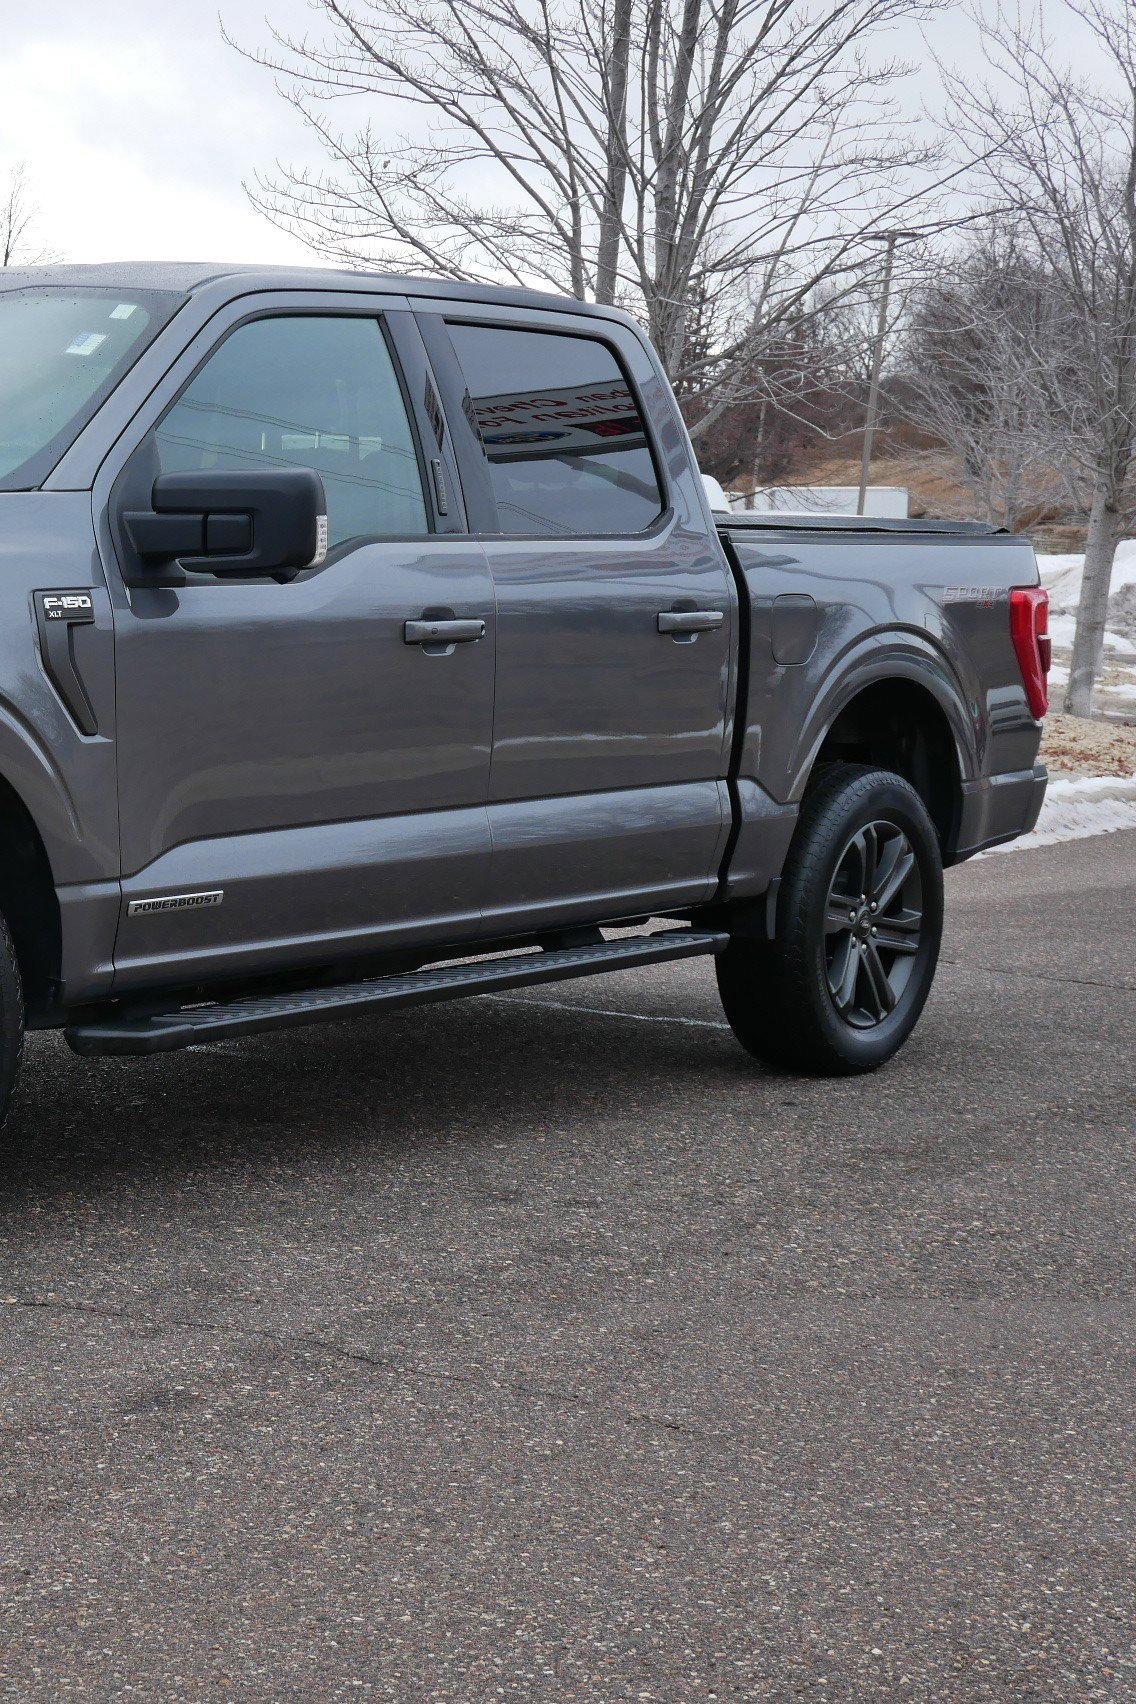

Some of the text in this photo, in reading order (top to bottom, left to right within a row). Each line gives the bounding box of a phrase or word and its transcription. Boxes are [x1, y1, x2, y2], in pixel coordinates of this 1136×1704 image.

[943, 585, 1005, 601] SPORT
[44, 596, 92, 608] F-150
[48, 610, 63, 618] XLT
[133, 894, 220, 913] POWERBOOST
